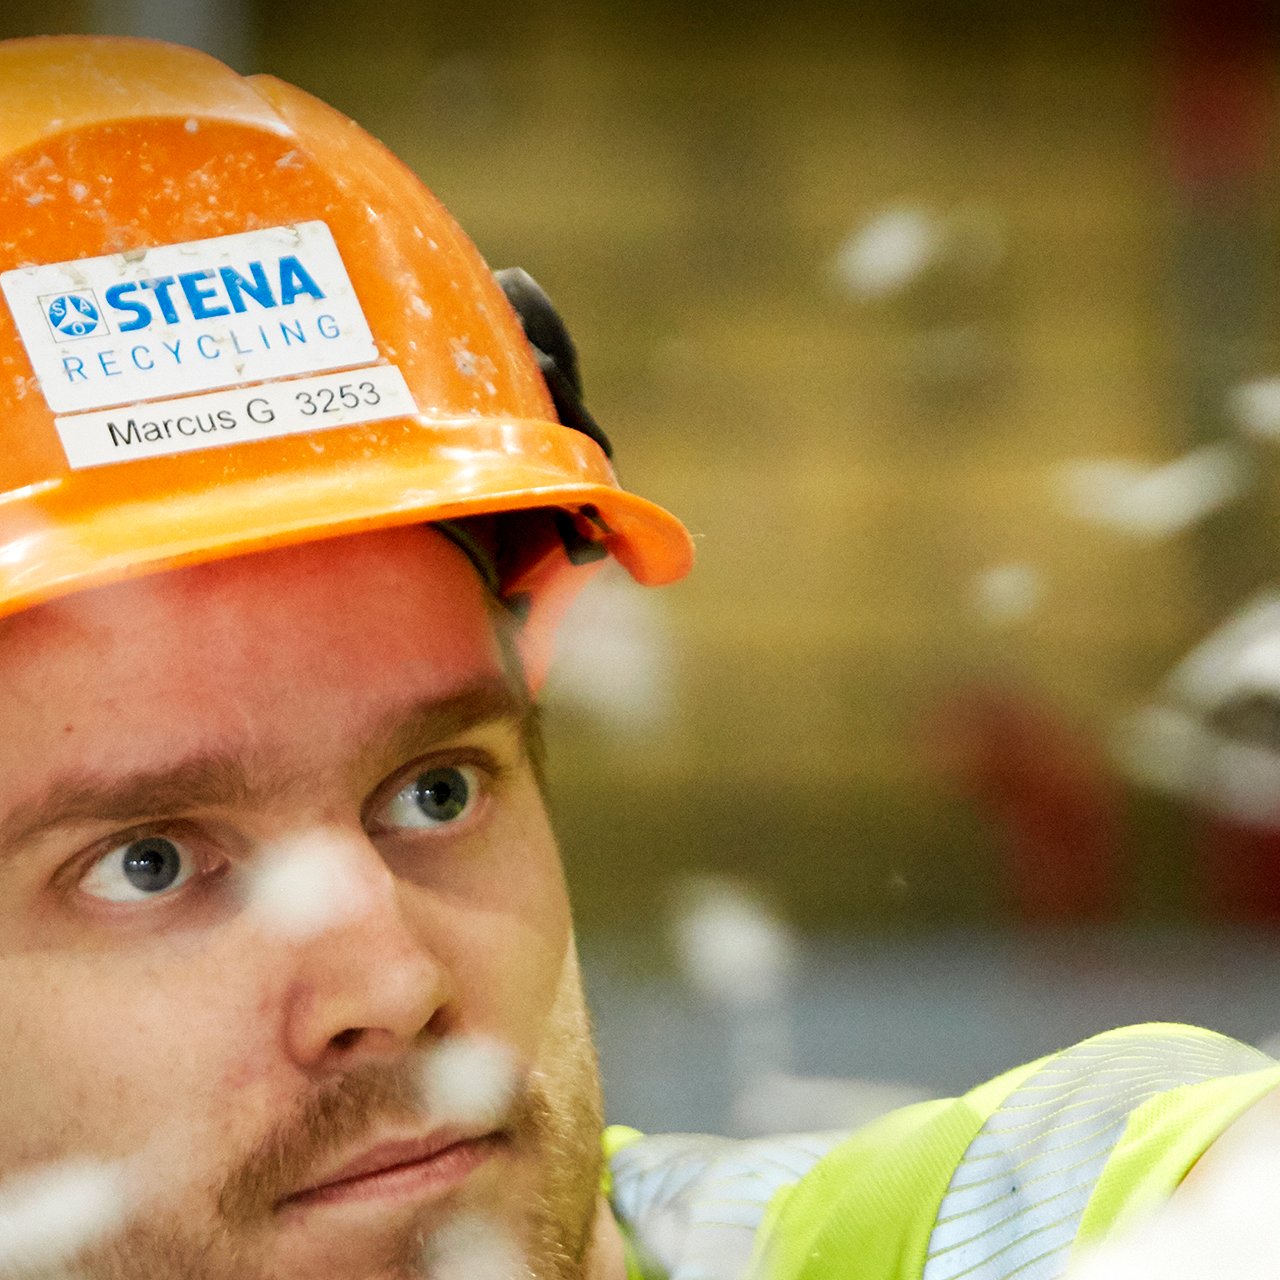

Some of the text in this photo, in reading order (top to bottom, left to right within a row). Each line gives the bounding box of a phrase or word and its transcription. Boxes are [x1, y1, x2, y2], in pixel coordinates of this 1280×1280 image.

[104, 255, 326, 333] STENA
[62, 314, 342, 383] RECYCLING
[106, 381, 382, 448] Marcus G 3253
